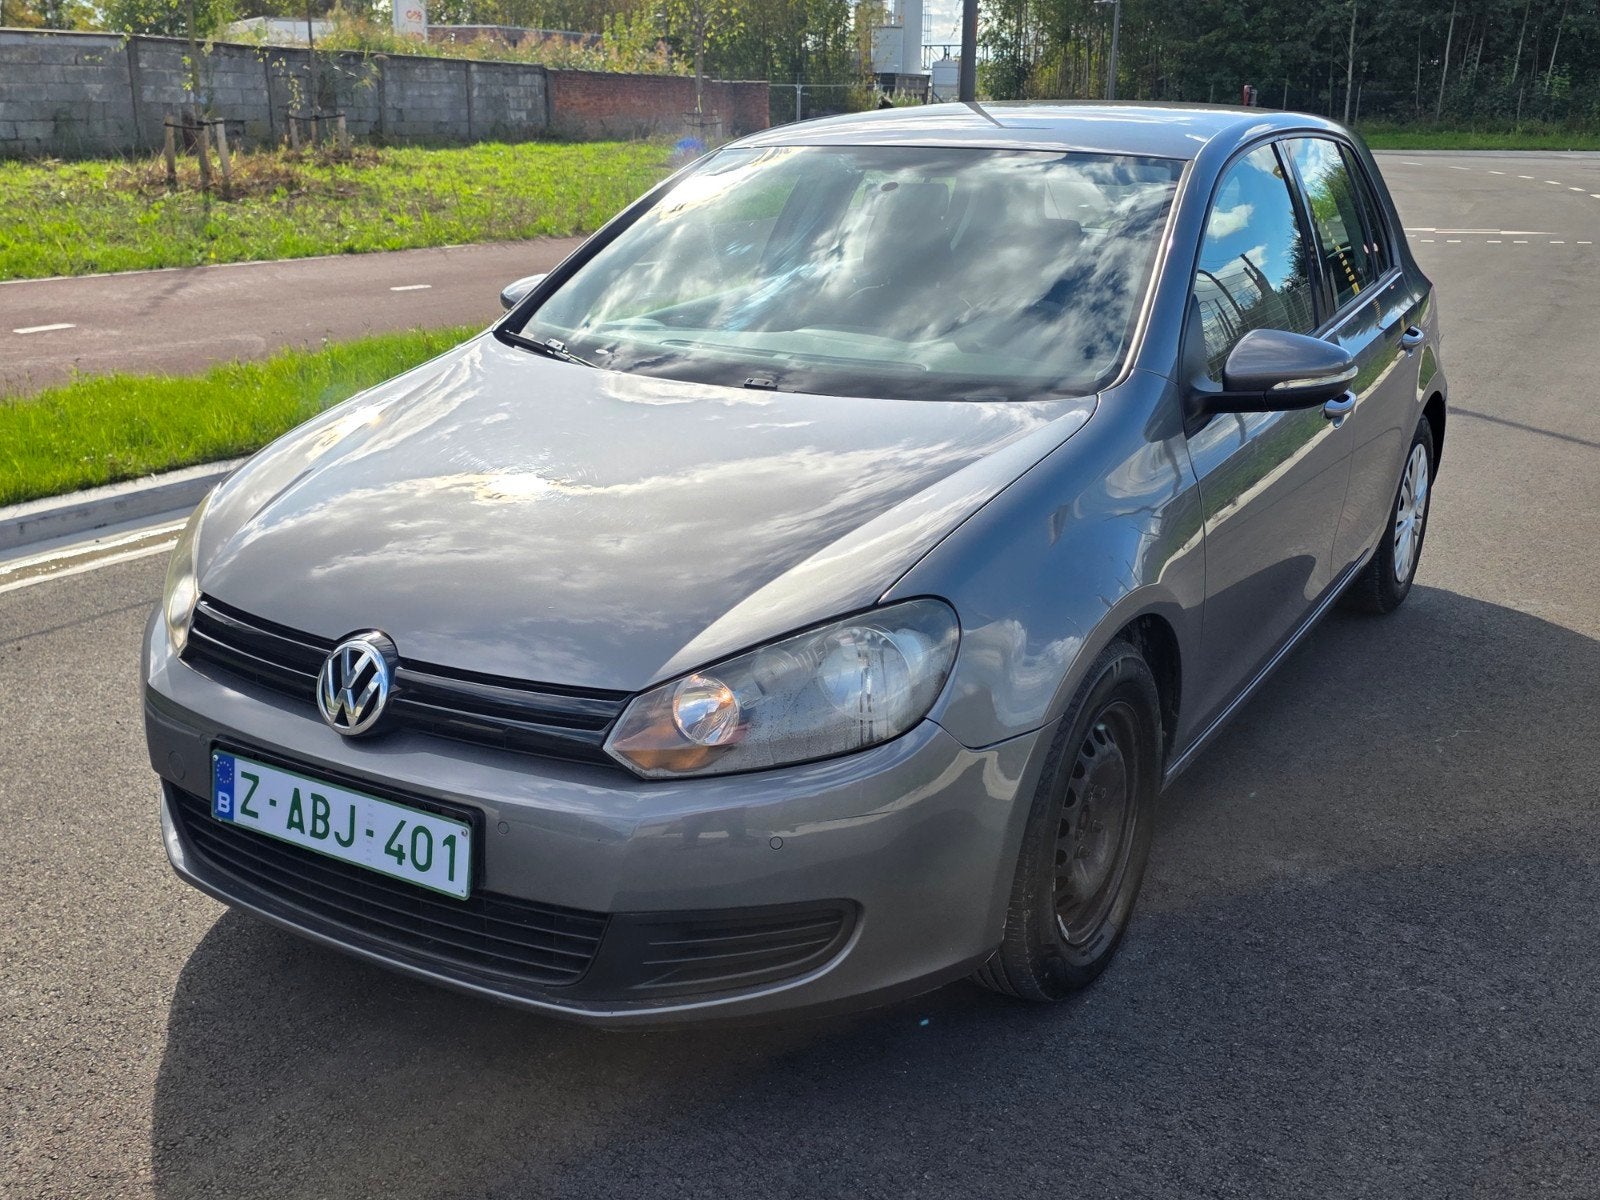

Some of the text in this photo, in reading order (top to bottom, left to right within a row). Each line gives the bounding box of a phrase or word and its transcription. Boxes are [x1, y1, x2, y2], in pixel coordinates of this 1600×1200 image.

[320, 642, 385, 731] VW
[217, 791, 230, 813] B
[240, 771, 456, 882] Z-ABJ-401
